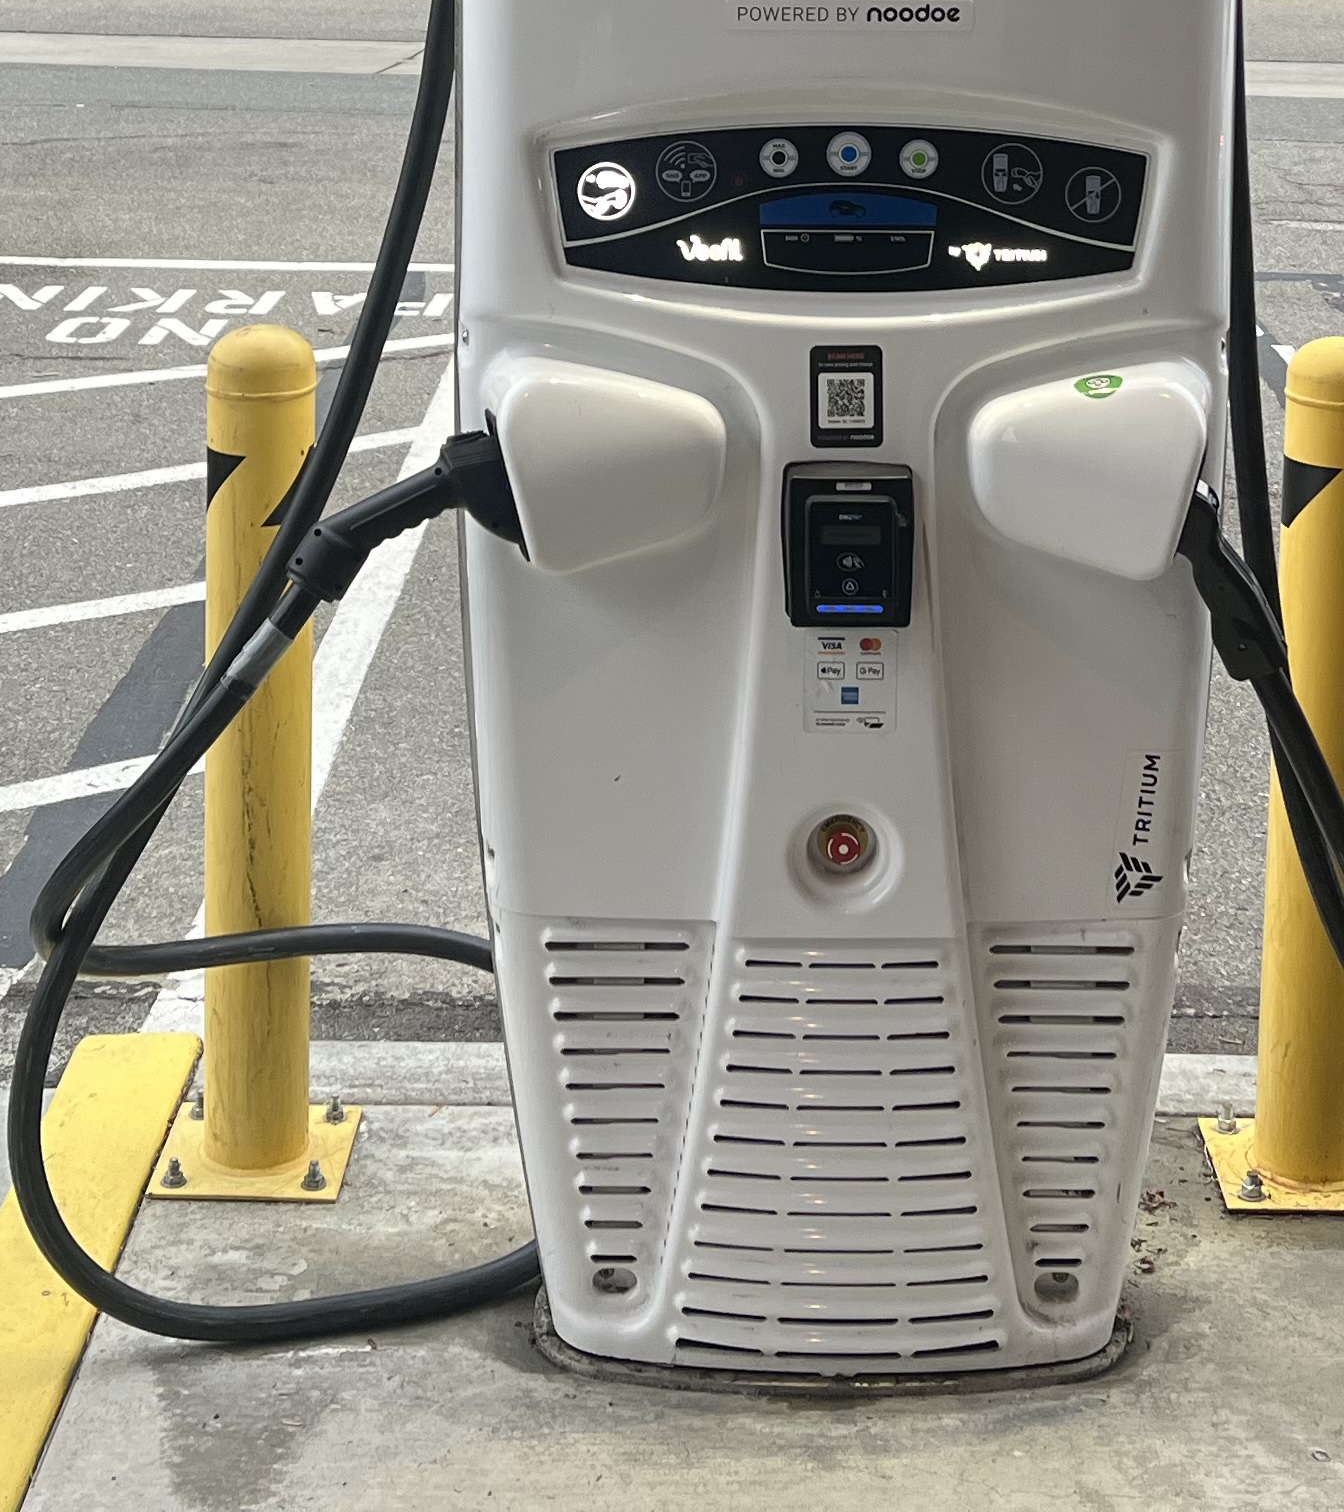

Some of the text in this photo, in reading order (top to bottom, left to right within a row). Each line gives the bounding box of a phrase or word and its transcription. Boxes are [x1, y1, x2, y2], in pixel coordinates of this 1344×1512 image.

[737, 4, 961, 23] POWERED BY noodoe
[45, 315, 229, 346] NO
[821, 641, 843, 650] VISA
[868, 667, 881, 675] Pay
[1133, 754, 1161, 846] TRITIUM
